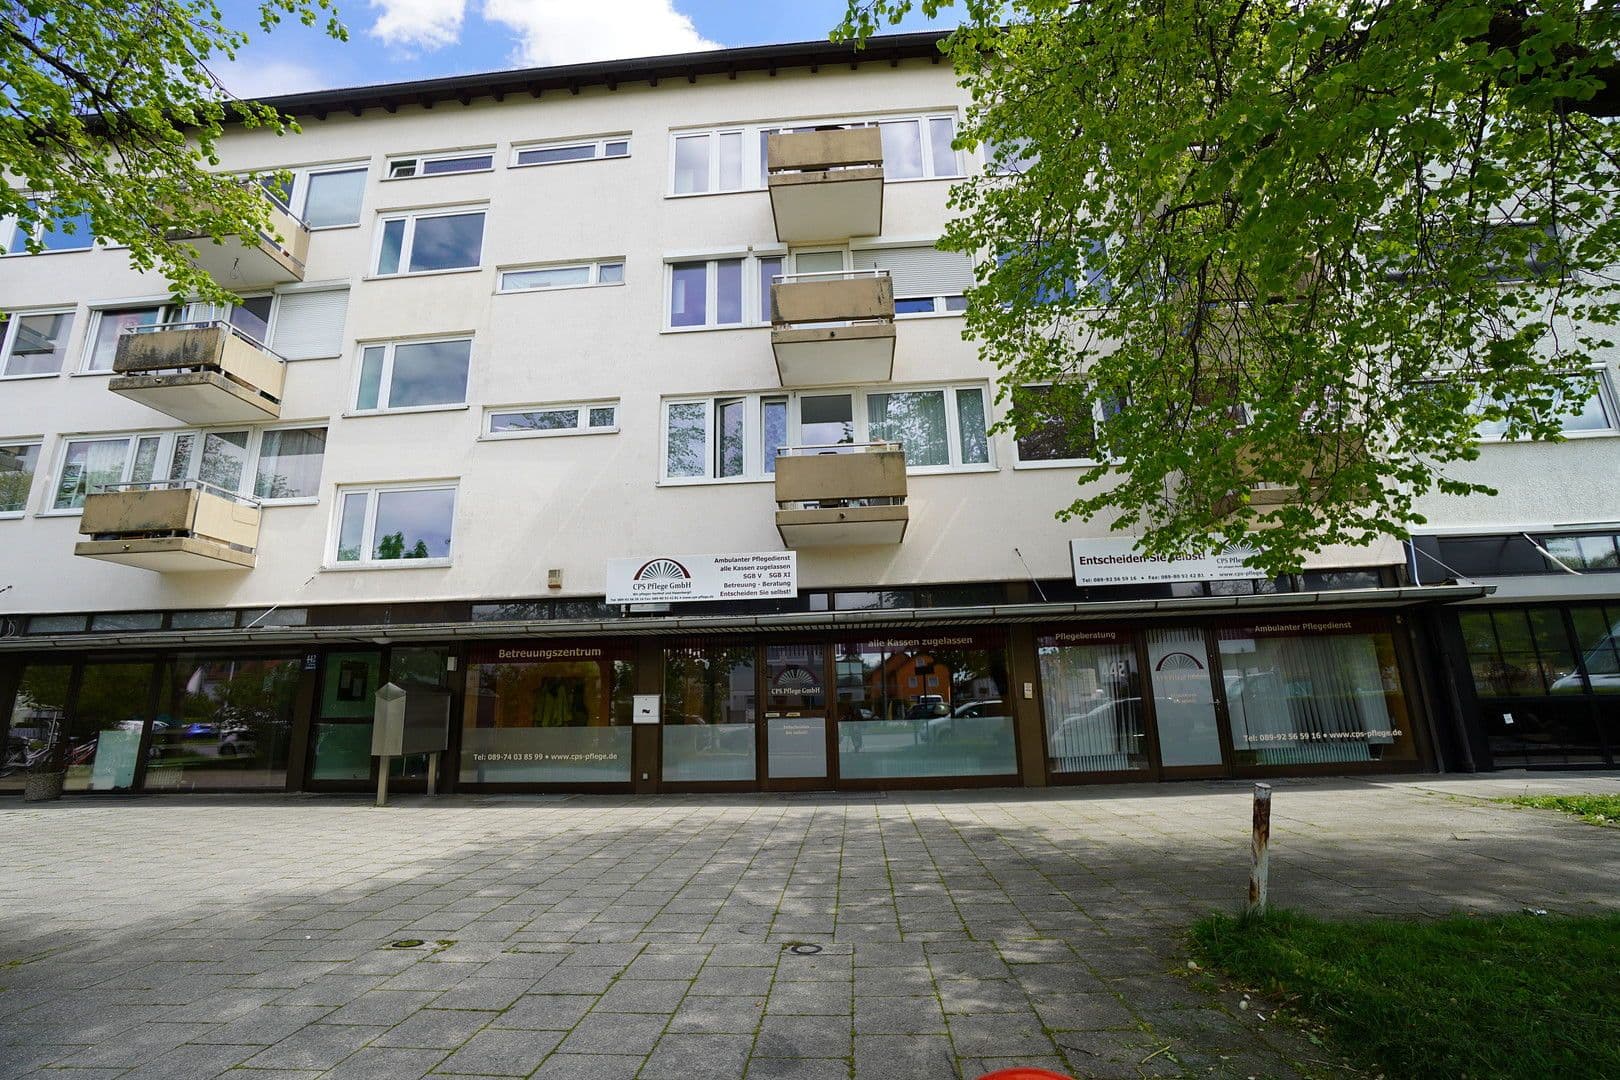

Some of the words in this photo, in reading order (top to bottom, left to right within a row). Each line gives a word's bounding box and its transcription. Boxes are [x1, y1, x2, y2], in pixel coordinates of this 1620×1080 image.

[1080, 554, 1146, 565] Entscheiden
[1150, 553, 1166, 562] Sie
[1168, 552, 1206, 562] elbst!
[647, 583, 668, 591] Pflege
[670, 581, 691, 589] GmbH
[1255, 624, 1300, 633] Ambulanter
[1302, 621, 1352, 631] Pflegedienst
[868, 639, 885, 648] alle
[887, 638, 920, 647] Kassen
[921, 636, 973, 647] zugelassen
[1056, 632, 1116, 642] Pflegeberatung
[498, 648, 601, 659] Betreuungszentrum
[783, 687, 801, 695] Pflege
[1288, 733, 1298, 741] 56
[1300, 732, 1309, 740] 59
[1329, 729, 1402, 739] www.cps-pflege.de
[473, 753, 486, 761] Tel:
[487, 753, 512, 761] 089-74
[551, 753, 618, 761] www.cps-pflege.de
